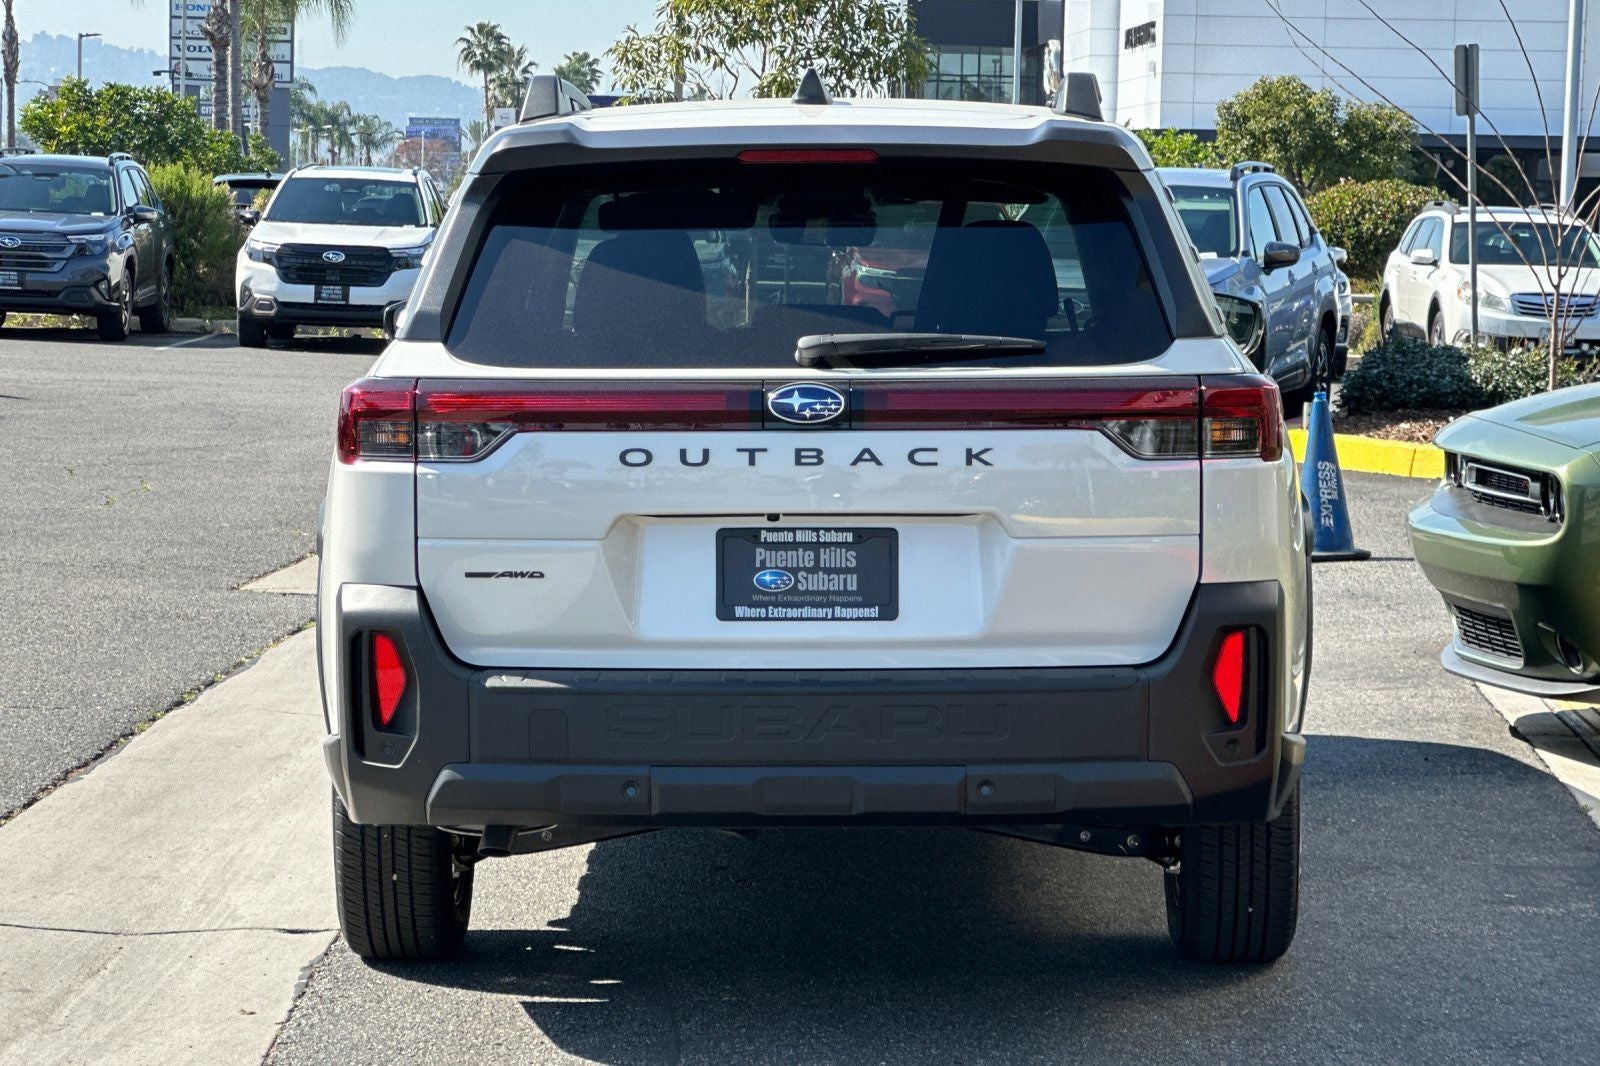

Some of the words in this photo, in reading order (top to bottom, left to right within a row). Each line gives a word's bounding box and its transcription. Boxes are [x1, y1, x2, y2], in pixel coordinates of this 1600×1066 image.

[618, 448, 994, 467] OUTBACK
[1329, 463, 1339, 500] SERVICE
[1318, 461, 1334, 529] EXPRESS
[760, 530, 793, 543] Puente
[795, 530, 818, 543] Hills
[819, 530, 853, 543] Subaru
[755, 548, 815, 568] Puente
[819, 548, 857, 568] Hills
[494, 570, 545, 579] AWD
[797, 571, 858, 591] Subaru
[752, 594, 776, 602] Where
[778, 594, 828, 603] Extraordinary
[829, 594, 863, 603] Happens
[735, 606, 767, 618] Where
[768, 606, 833, 620] Extraordinary
[834, 606, 879, 620] Happens!
[606, 704, 1010, 743] SUBARU
